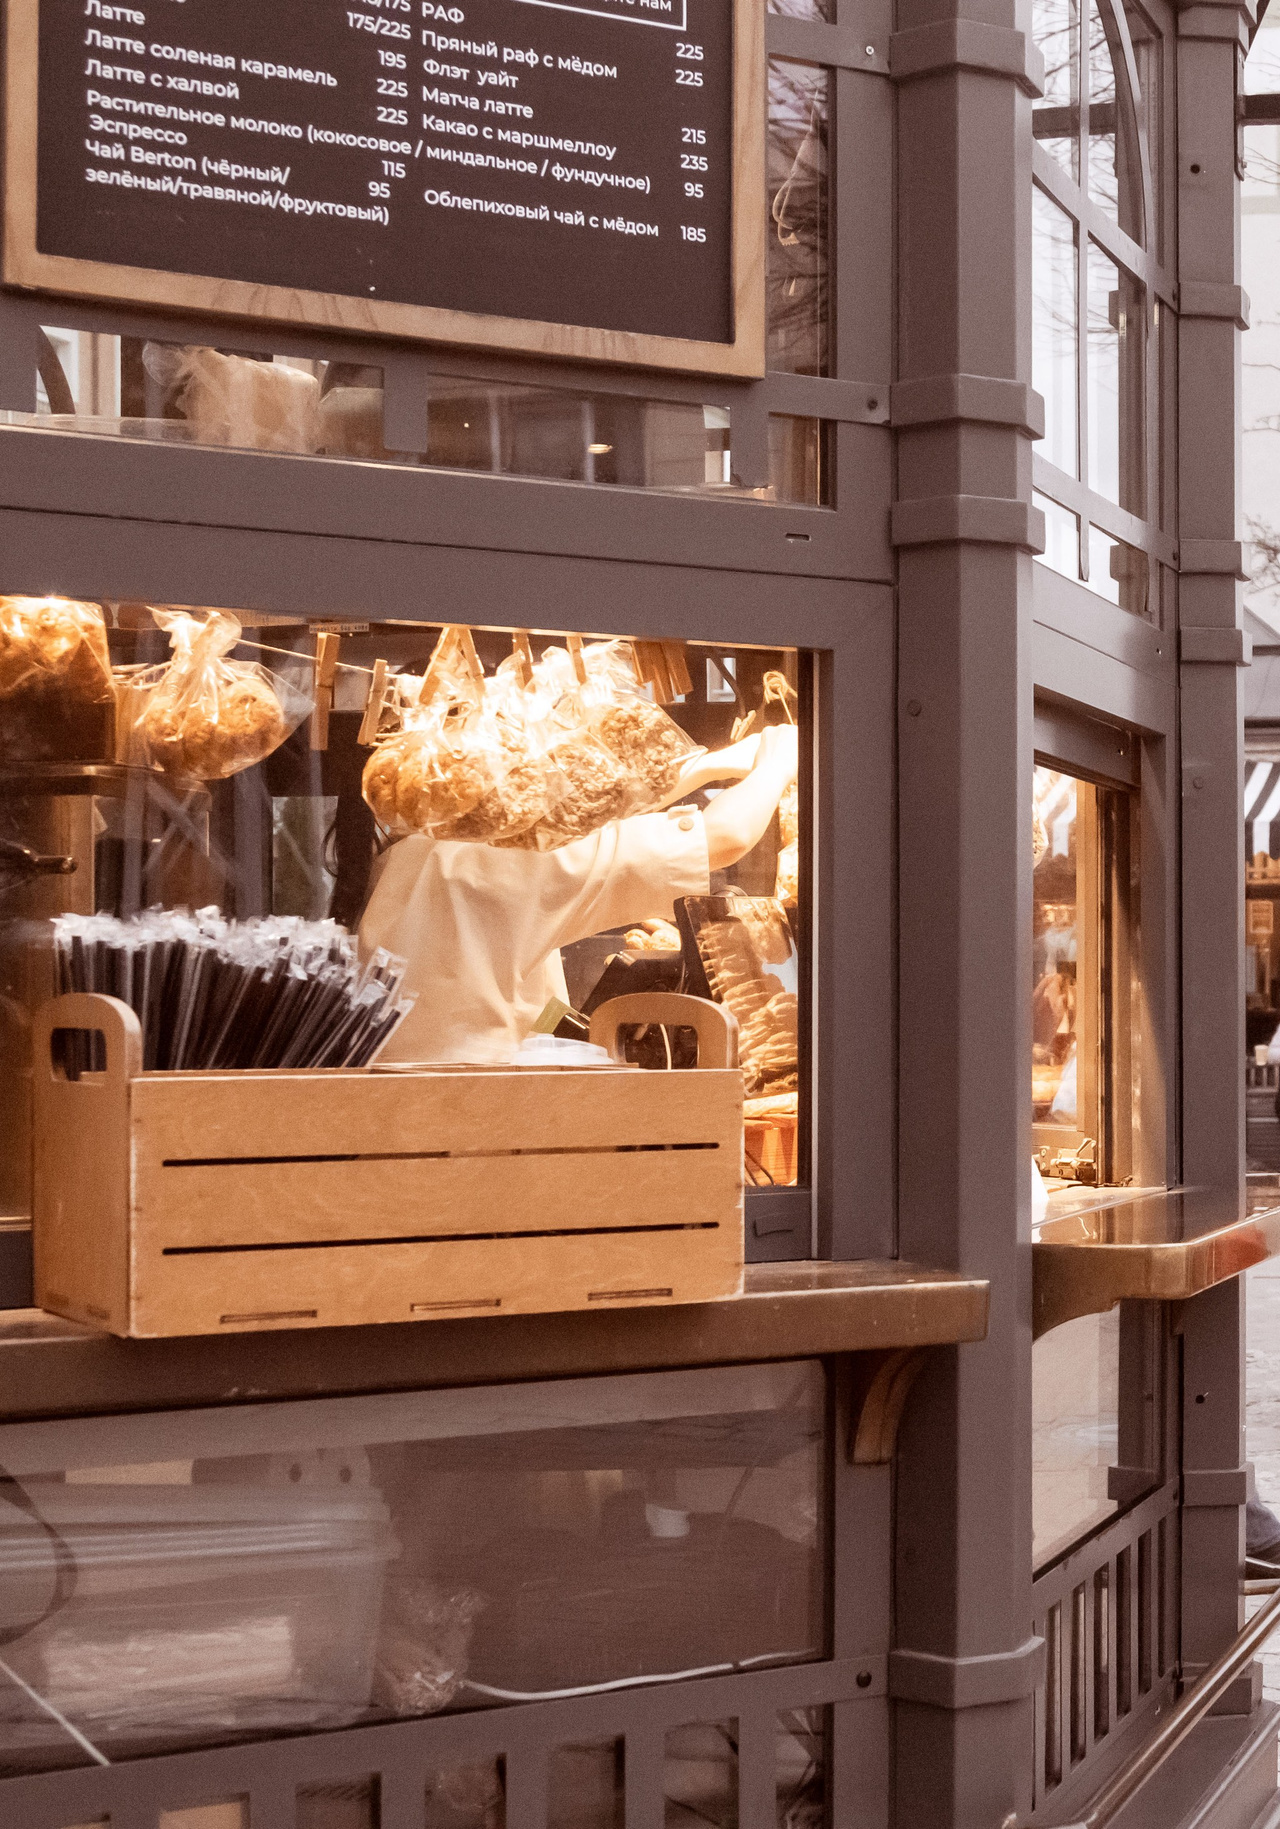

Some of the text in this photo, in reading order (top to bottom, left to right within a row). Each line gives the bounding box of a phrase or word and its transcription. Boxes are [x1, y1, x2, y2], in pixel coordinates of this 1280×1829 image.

[84, 0, 407, 69] Латте 195
[347, 11, 411, 40] 175/225
[421, 2, 704, 61] РАФ 225
[84, 29, 408, 98] Латте соленая карамель 225
[422, 30, 704, 87] Пряный раф с мёдом 225
[423, 58, 519, 88] Флэт уайт
[84, 59, 408, 126] Латте с халвой 225
[422, 86, 707, 145] Матча латте 215
[85, 139, 391, 198] Чай Berton (чёрный/ 95
[87, 89, 226, 127] Растительное
[230, 116, 303, 138] молоко
[307, 124, 412, 154] (кокосовое
[426, 146, 538, 174] миндальное
[551, 162, 651, 194] фундучное)
[684, 182, 704, 198] 95
[89, 114, 406, 179] Эспрессо 115
[422, 114, 708, 172] Какао с маршмеллоу 235
[85, 168, 390, 226] зелёный/травяной/фруктовый)
[424, 189, 707, 243] Облепиховый чай с мёдом 185
